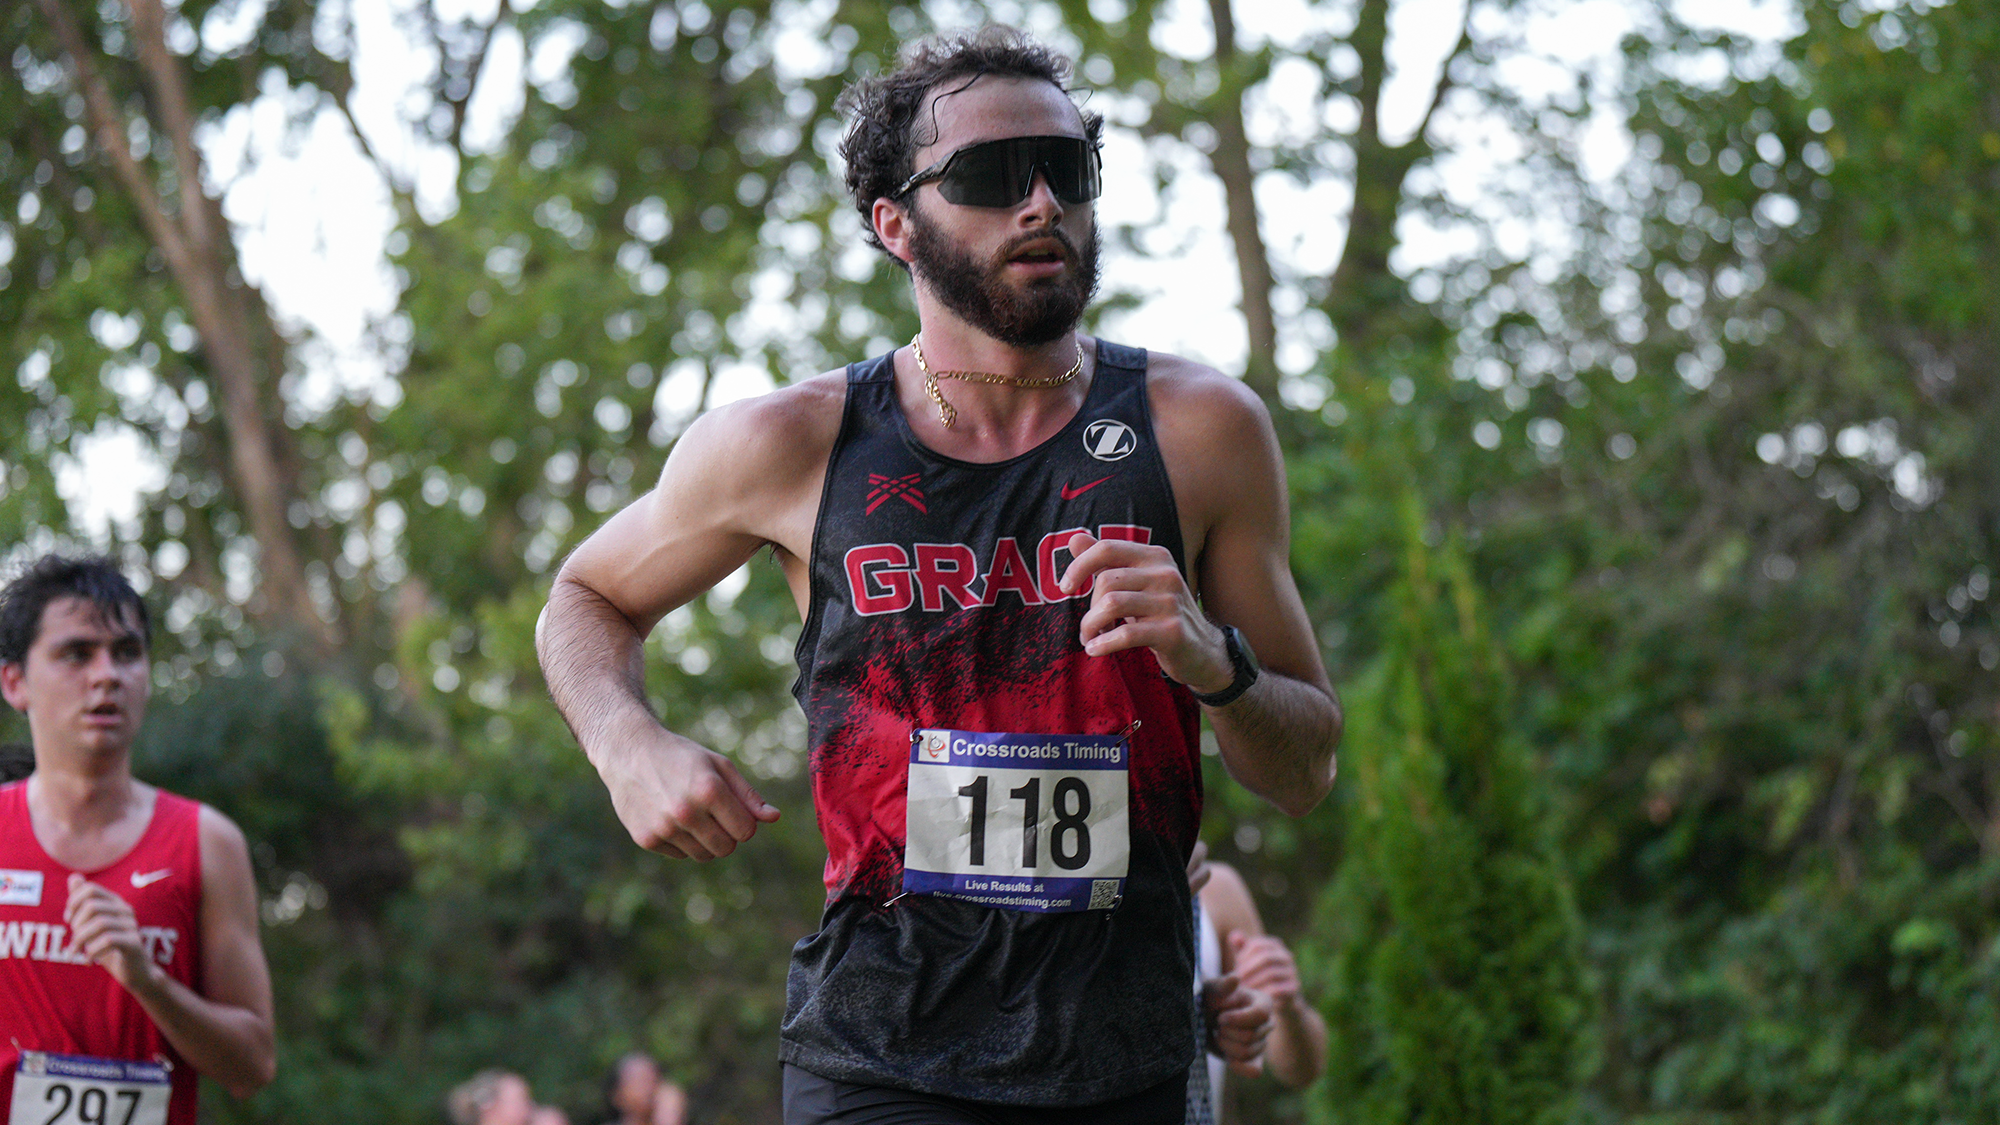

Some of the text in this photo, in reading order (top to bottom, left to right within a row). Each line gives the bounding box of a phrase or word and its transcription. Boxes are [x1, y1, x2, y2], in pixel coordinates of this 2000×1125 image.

[953, 739, 1121, 763] Crossroads Timing
[958, 776, 1092, 870] 118
[965, 880, 1045, 892] Live Results at
[0, 921, 179, 966] WILTS
[45, 1084, 142, 1125] 297
